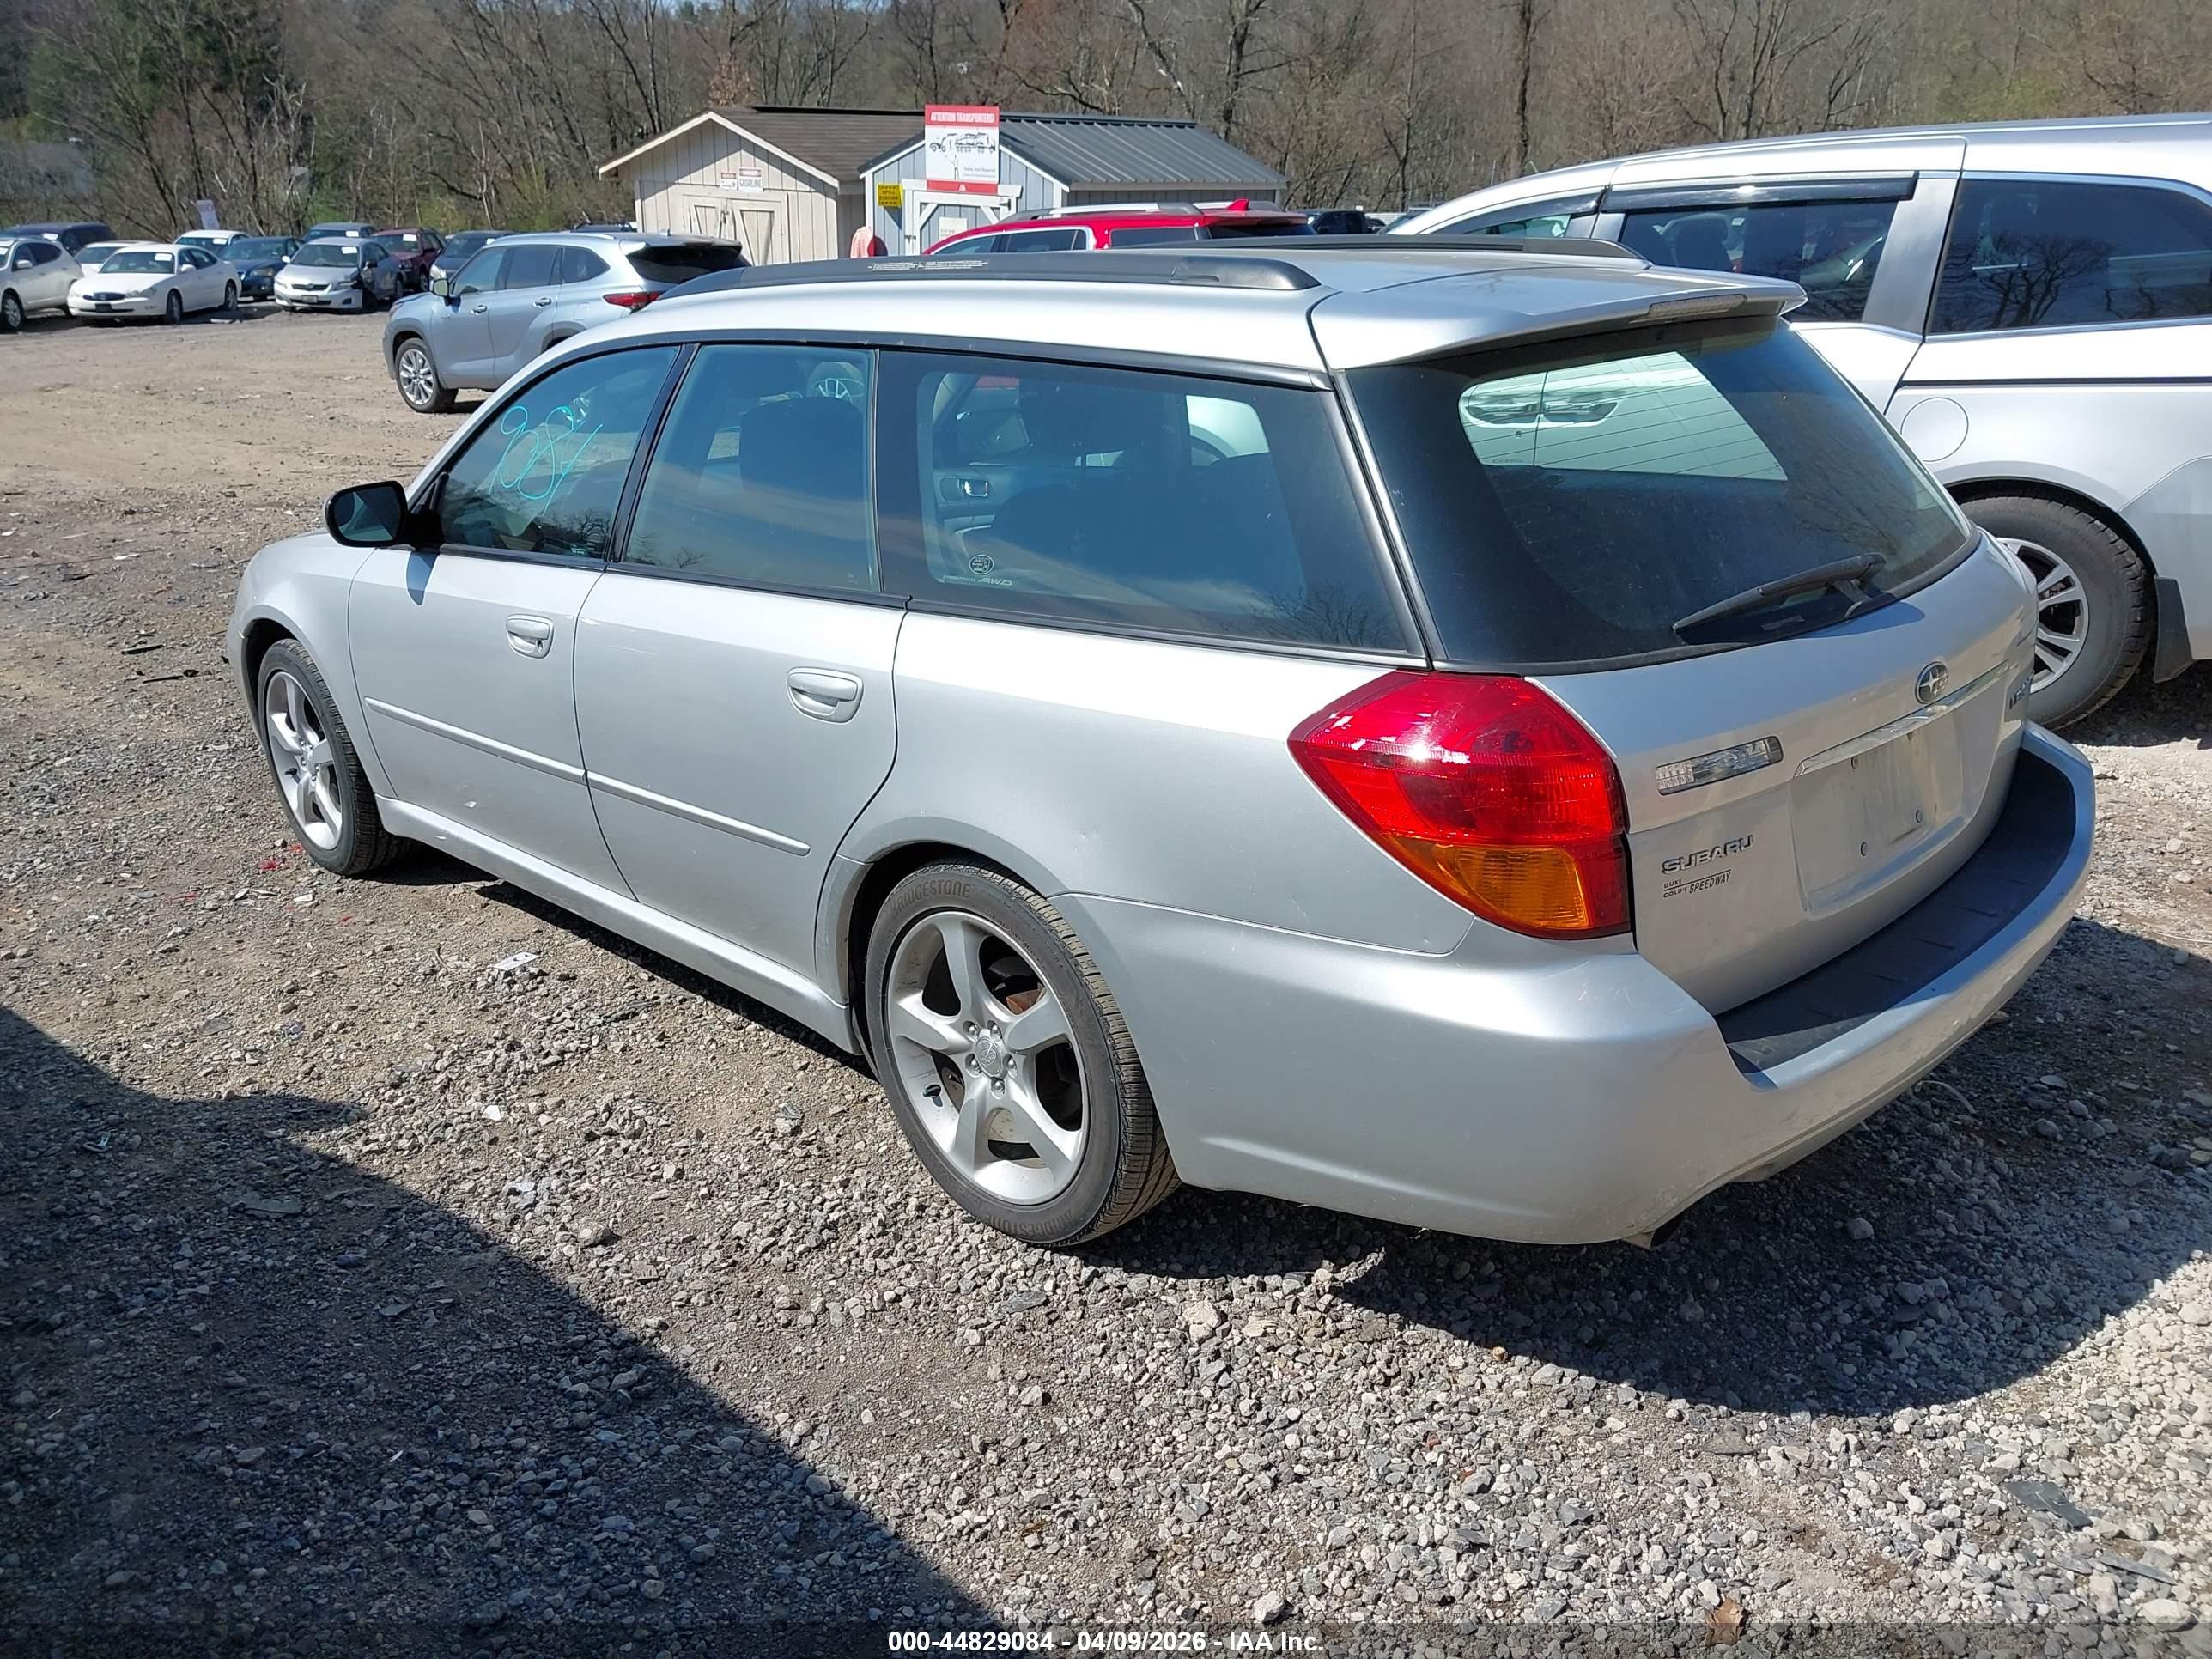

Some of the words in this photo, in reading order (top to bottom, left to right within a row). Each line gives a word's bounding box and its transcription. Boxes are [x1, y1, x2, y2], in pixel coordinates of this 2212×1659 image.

[977, 577, 1012, 586] AWD
[1662, 834, 1754, 875] SUBARU
[1689, 872, 1731, 894] SPEEDWAY
[891, 878, 971, 920] BRIDGESTONE
